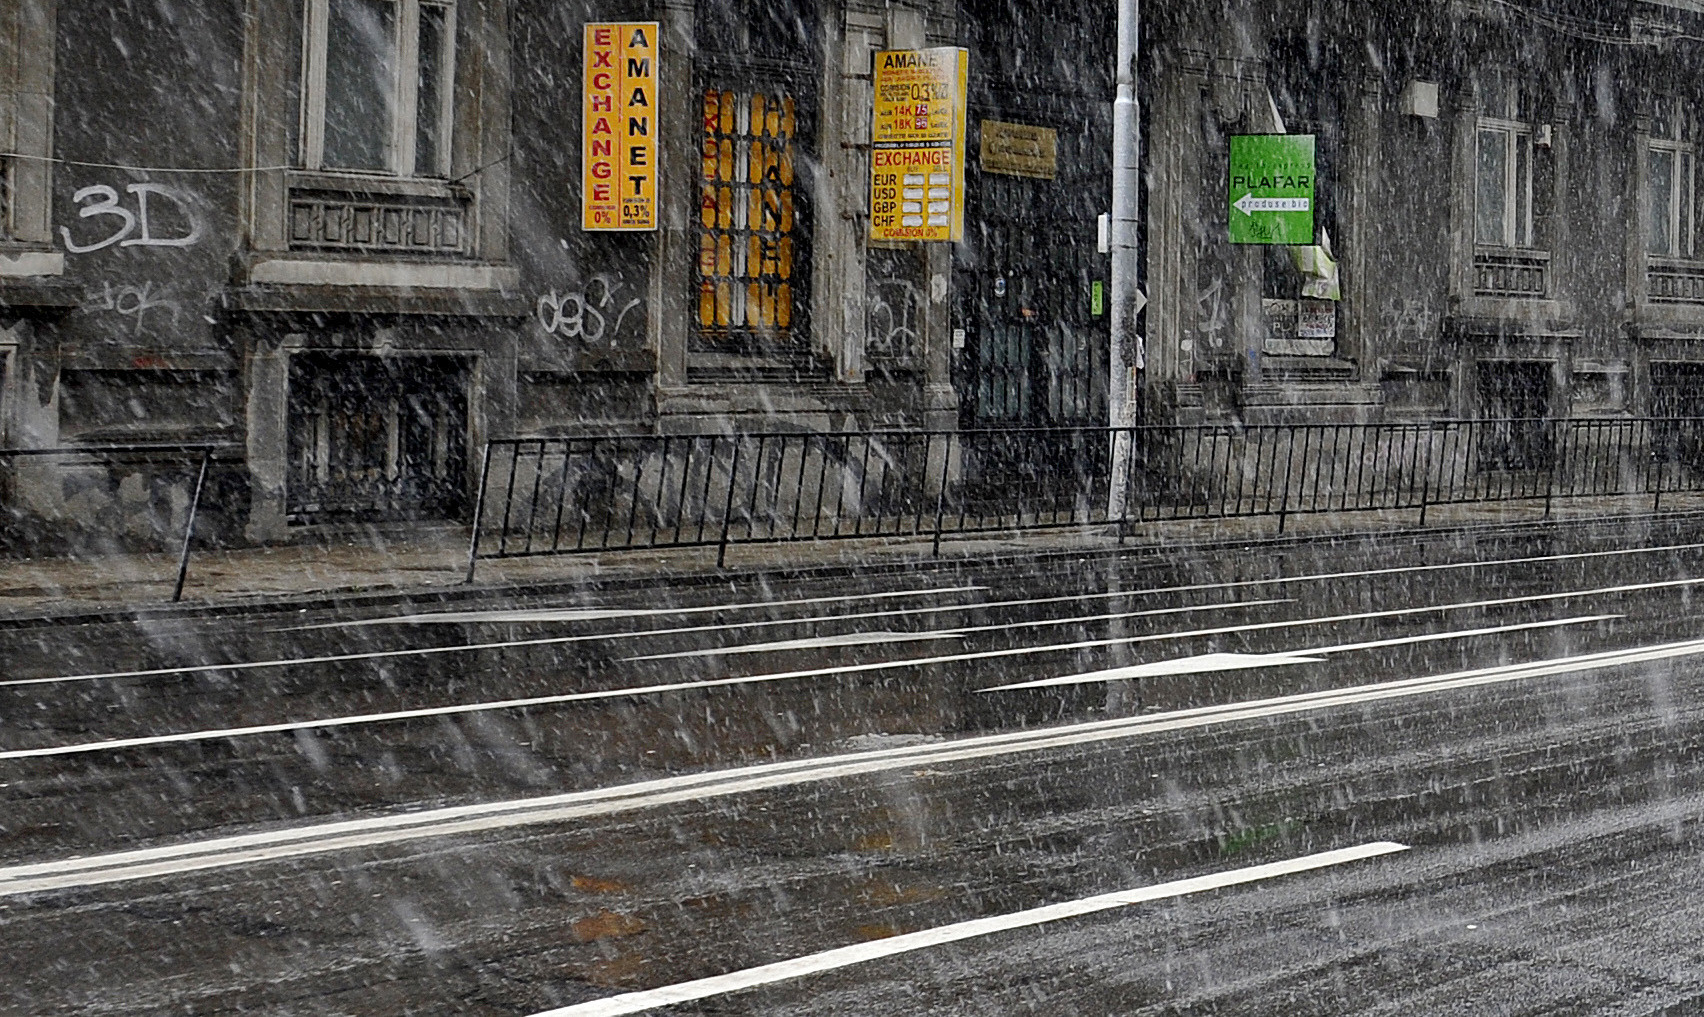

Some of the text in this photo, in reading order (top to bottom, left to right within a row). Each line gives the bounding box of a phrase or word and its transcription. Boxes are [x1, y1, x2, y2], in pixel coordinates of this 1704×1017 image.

[884, 53, 941, 69] AMANE
[592, 29, 612, 201] EXCHANGE
[628, 29, 649, 195] AMANET
[894, 105, 912, 116] 14K
[875, 151, 949, 166] EXCHANGE
[874, 174, 897, 186] EUR
[1233, 176, 1310, 189] PLAFAR
[874, 188, 896, 199] USD
[874, 202, 897, 213] GBP
[1241, 200, 1308, 209] produse bio
[594, 211, 611, 223] 0%
[623, 205, 649, 219] 0,3%
[874, 215, 895, 227] CHF
